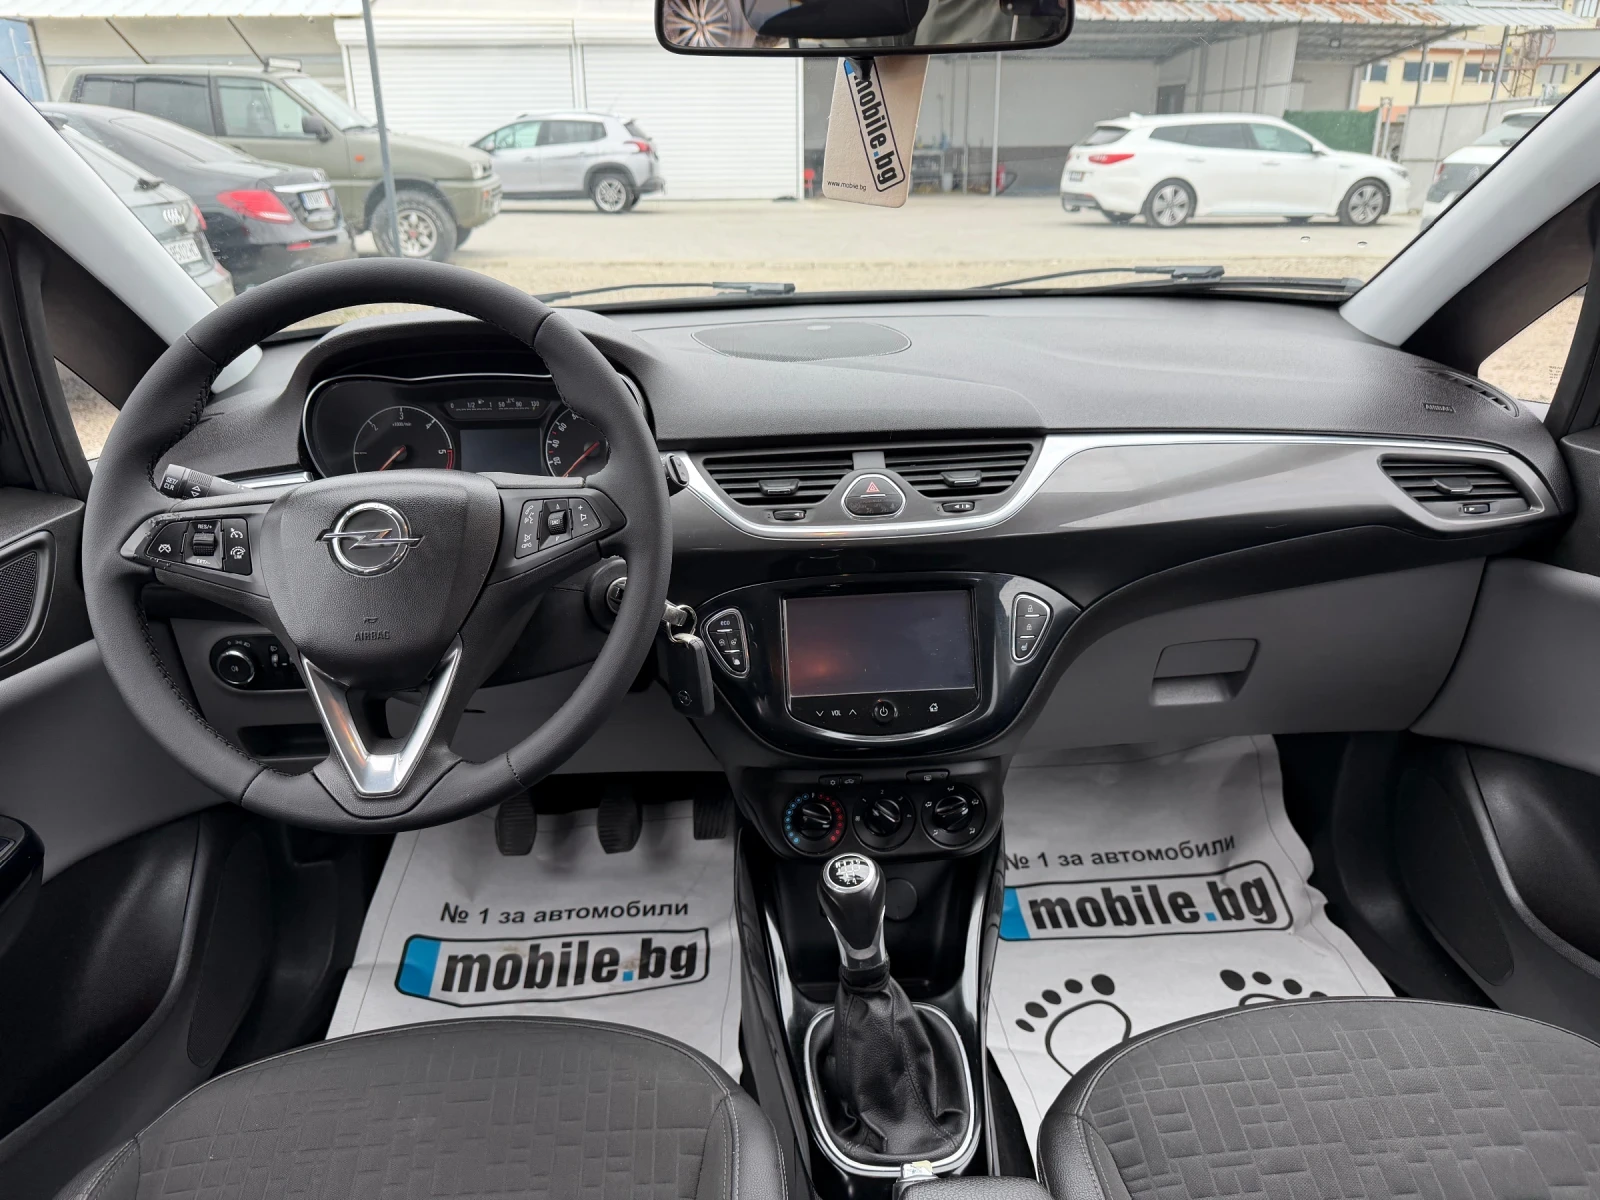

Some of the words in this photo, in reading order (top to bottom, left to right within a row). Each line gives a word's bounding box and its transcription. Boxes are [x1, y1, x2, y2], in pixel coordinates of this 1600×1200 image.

[827, 181, 867, 192] www.mobile.bg
[399, 412, 404, 420] 3
[372, 423, 379, 431] 2
[558, 422, 567, 432] 60
[552, 440, 560, 448] 40
[553, 456, 561, 465] 20
[163, 483, 175, 491] CLR
[354, 630, 390, 642] AIRBAG
[1005, 853, 1030, 871] №
[1037, 851, 1048, 868] 1
[1057, 853, 1083, 867] за
[1091, 835, 1236, 865] автомобили
[1028, 876, 1278, 930] mobile.bg
[440, 901, 469, 924] №
[478, 907, 490, 925] 1
[498, 910, 525, 924] за
[533, 900, 690, 924] автомобили
[441, 937, 698, 993] mobile.bg
